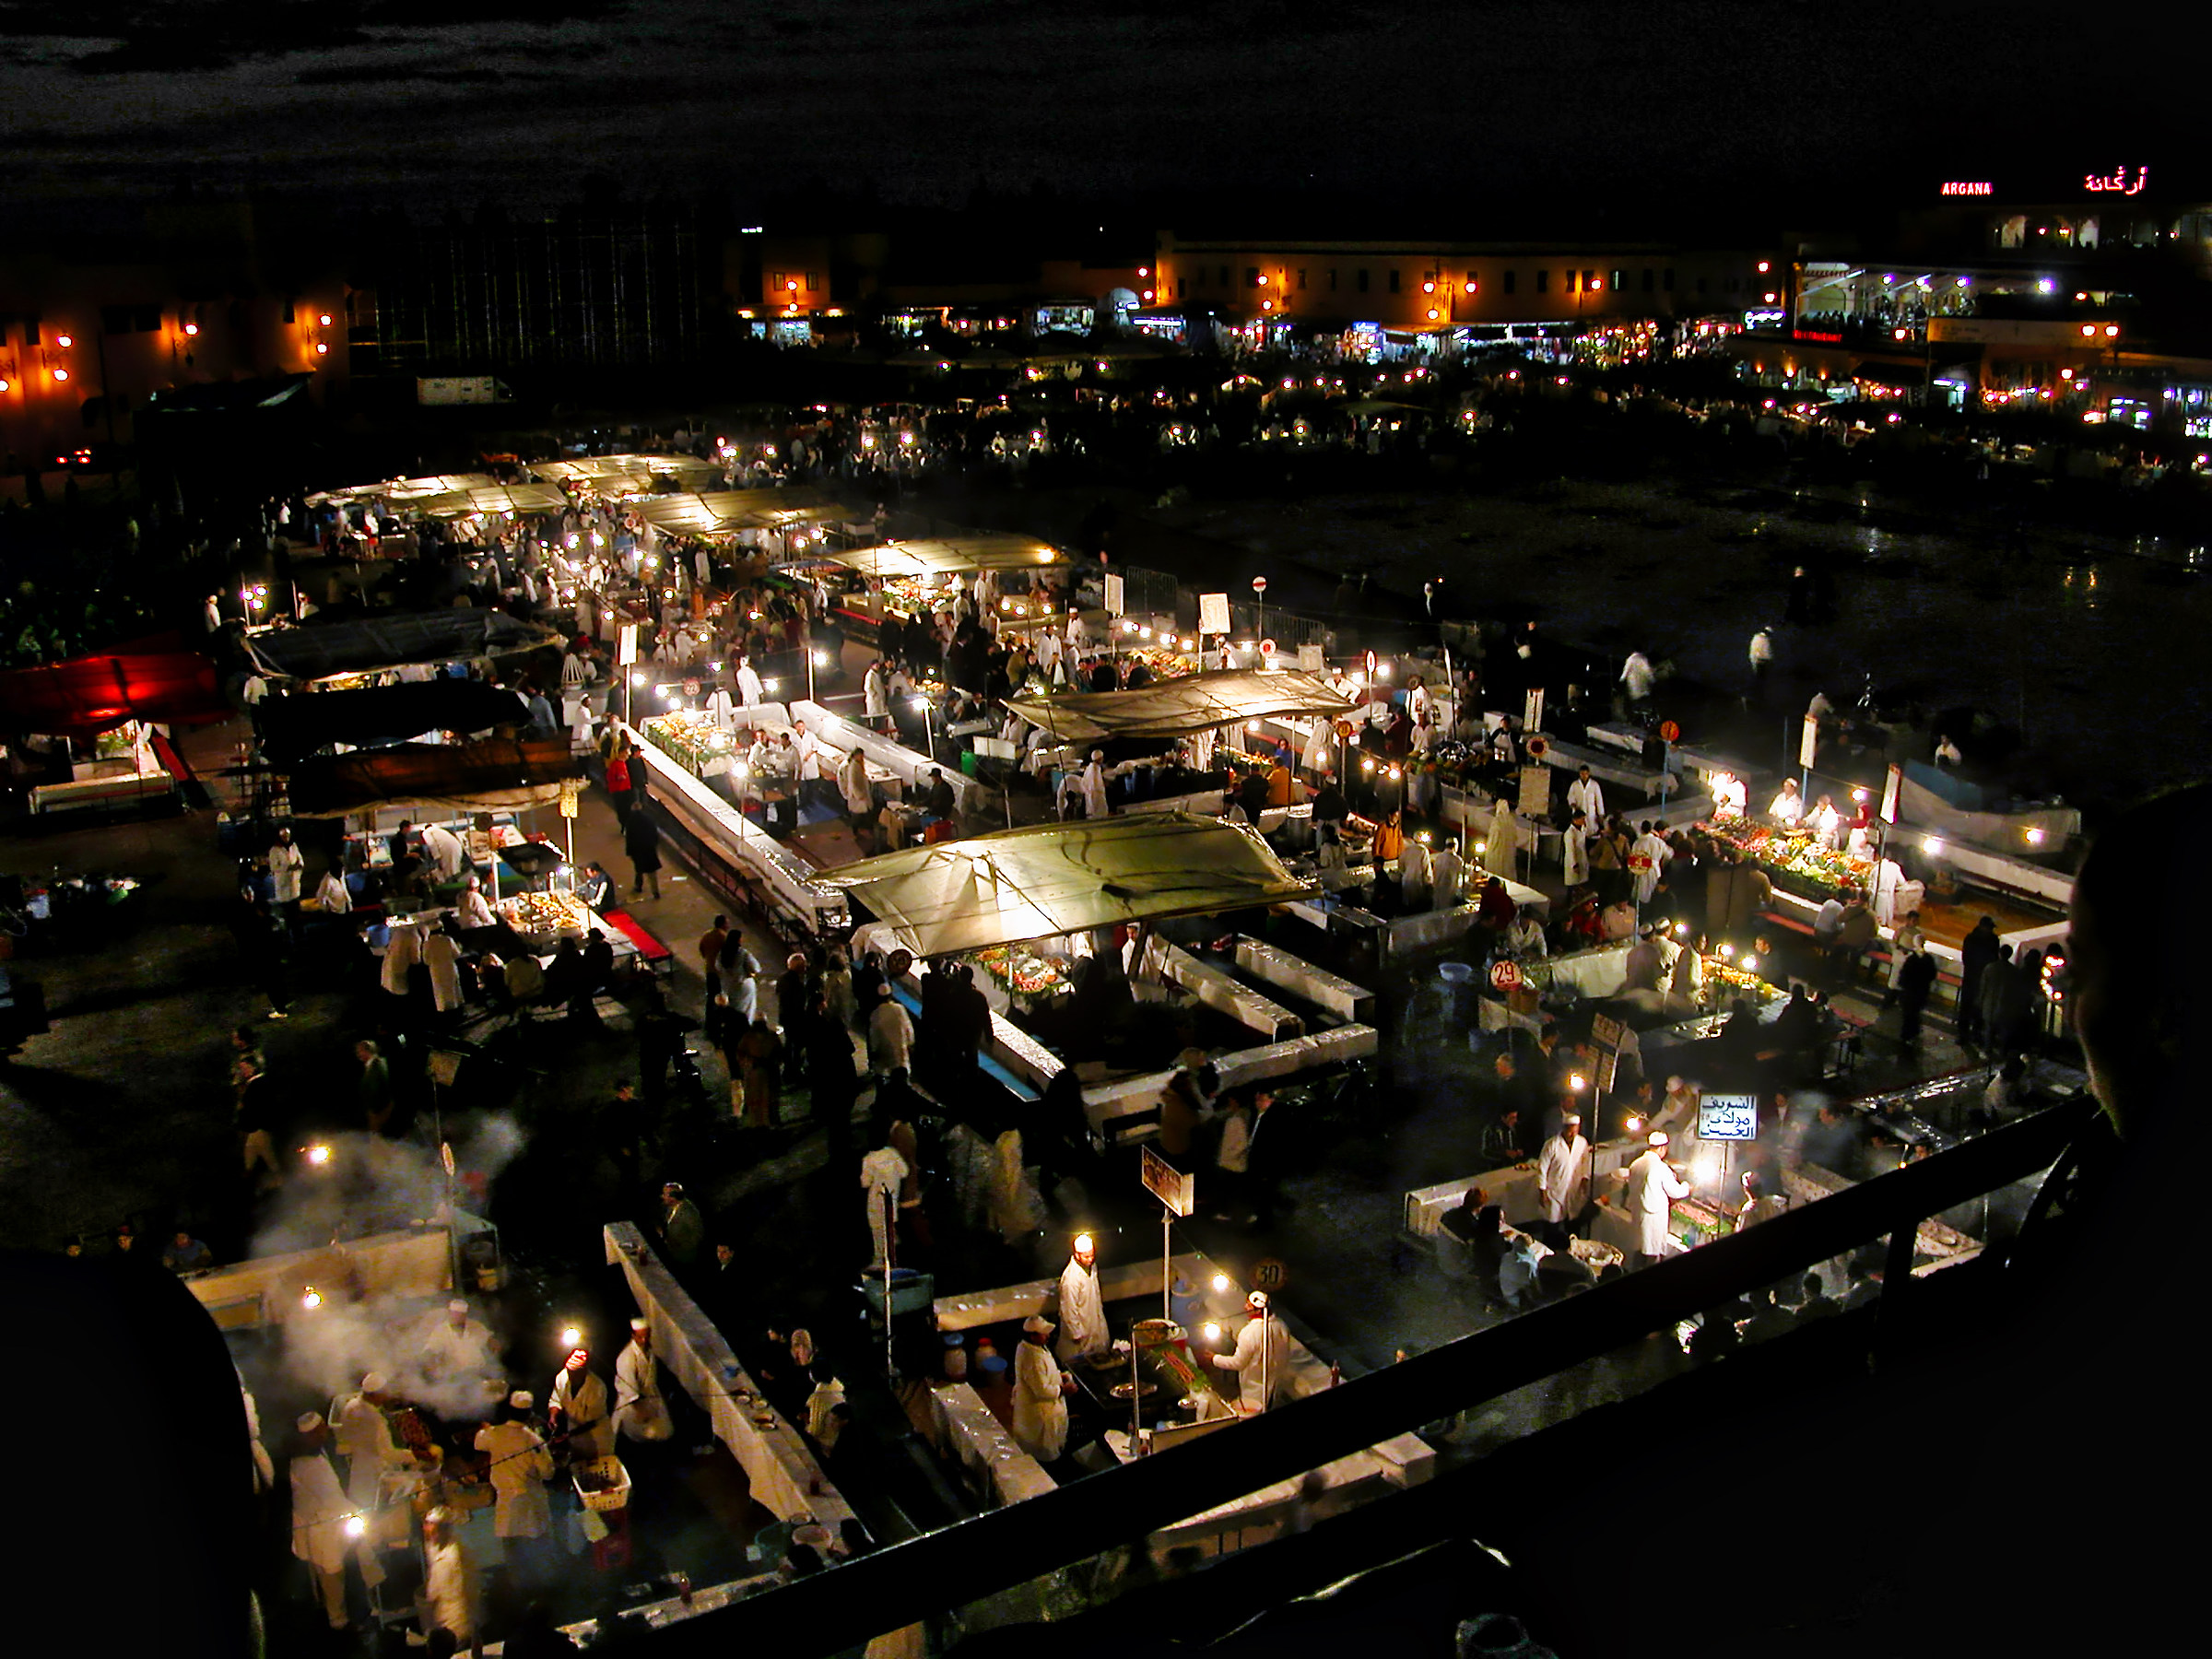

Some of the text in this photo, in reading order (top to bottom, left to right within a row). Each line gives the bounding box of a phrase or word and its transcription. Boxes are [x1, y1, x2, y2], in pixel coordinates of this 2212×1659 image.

[1941, 182, 1993, 195] ARGANA
[1495, 962, 1514, 982] 29
[1260, 1265, 1278, 1284] 30
